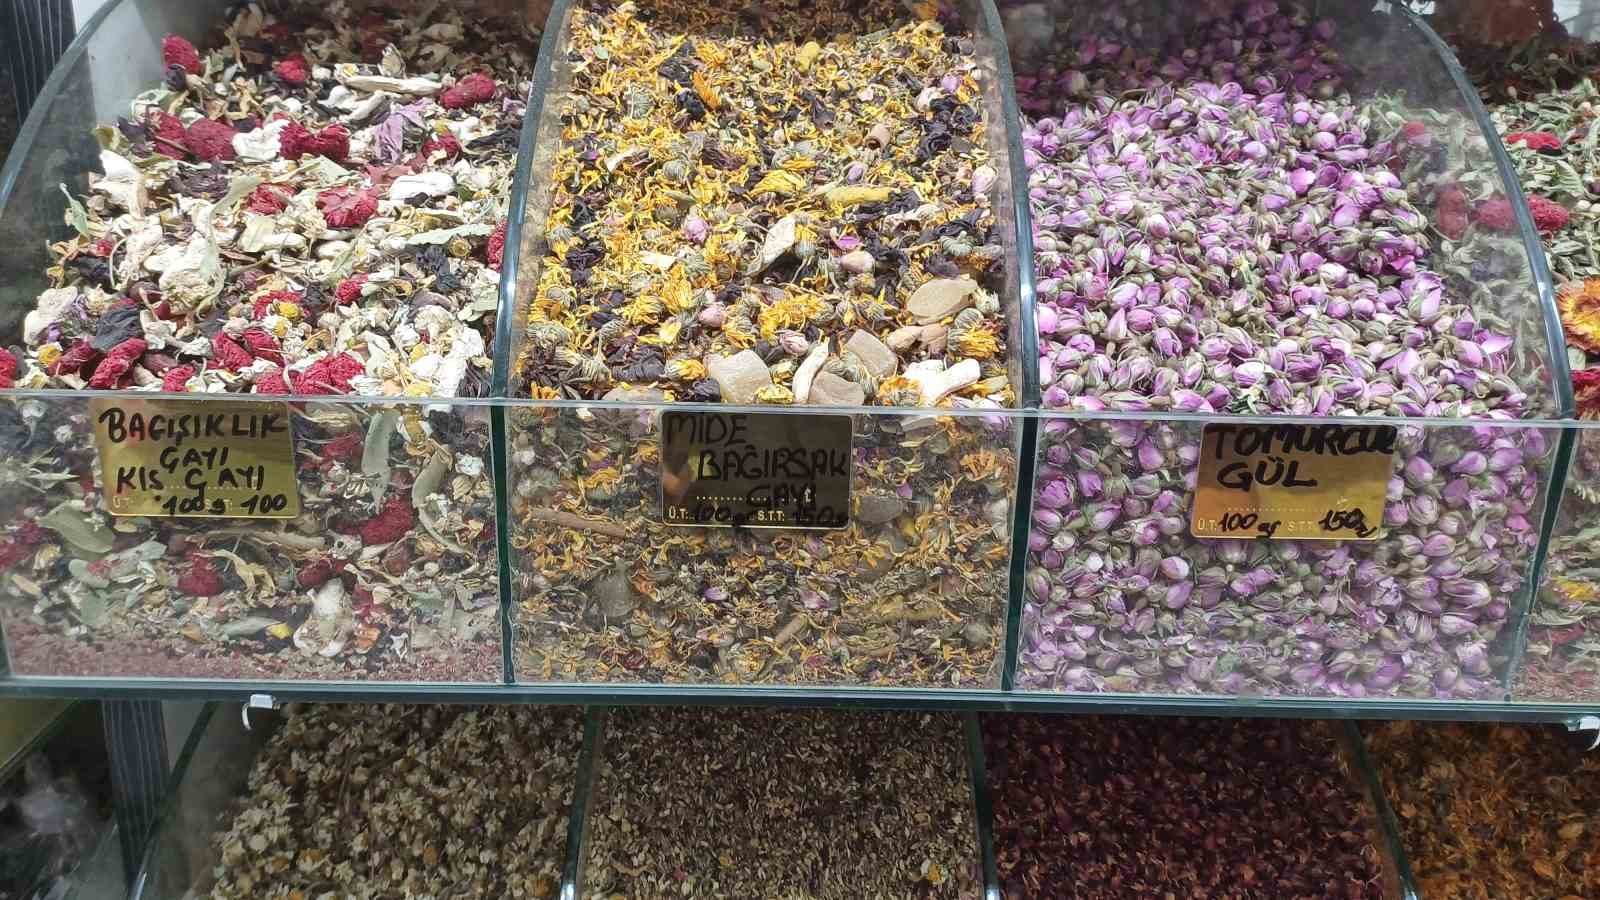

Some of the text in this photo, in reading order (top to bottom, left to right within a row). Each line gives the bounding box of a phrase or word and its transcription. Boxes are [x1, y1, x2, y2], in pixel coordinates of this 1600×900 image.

[1216, 456, 1318, 492] GÜL
[239, 493, 287, 515] 100
[1217, 512, 1259, 533] 100
